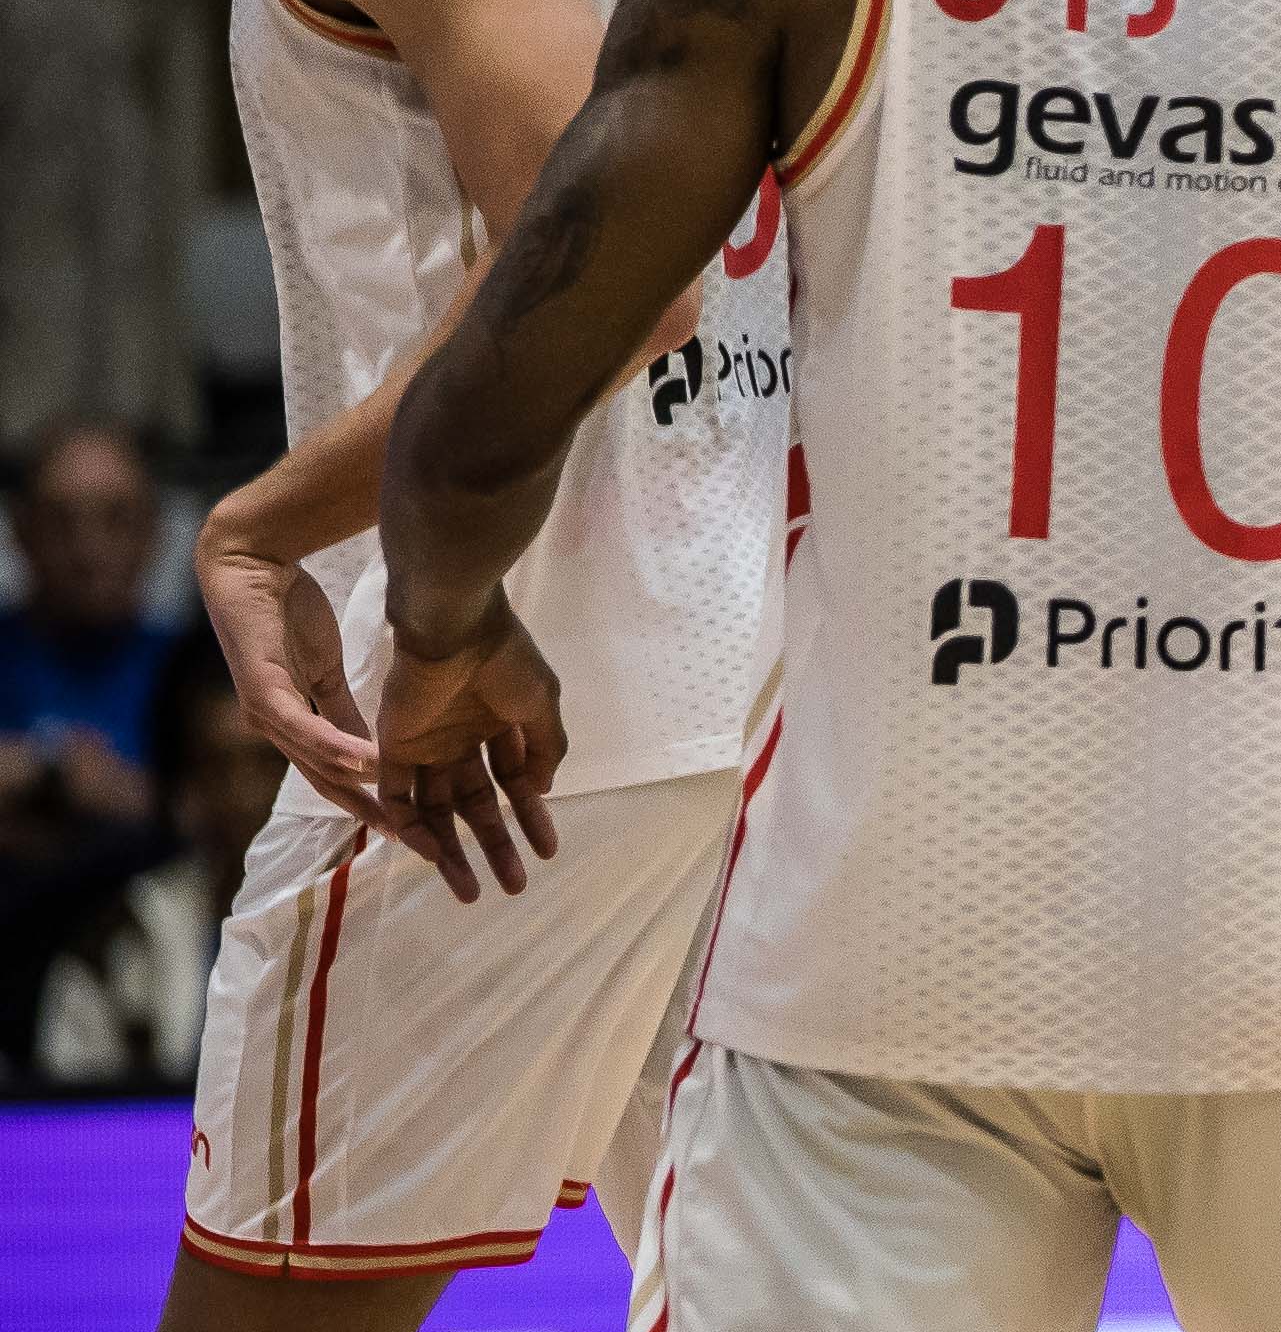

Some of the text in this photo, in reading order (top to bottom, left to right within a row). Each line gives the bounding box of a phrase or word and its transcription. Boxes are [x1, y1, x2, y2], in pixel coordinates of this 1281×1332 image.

[1024, 156, 1088, 184] fluid
[1100, 167, 1155, 189] and
[1165, 172, 1267, 194] motion
[717, 332, 793, 400] Prior
